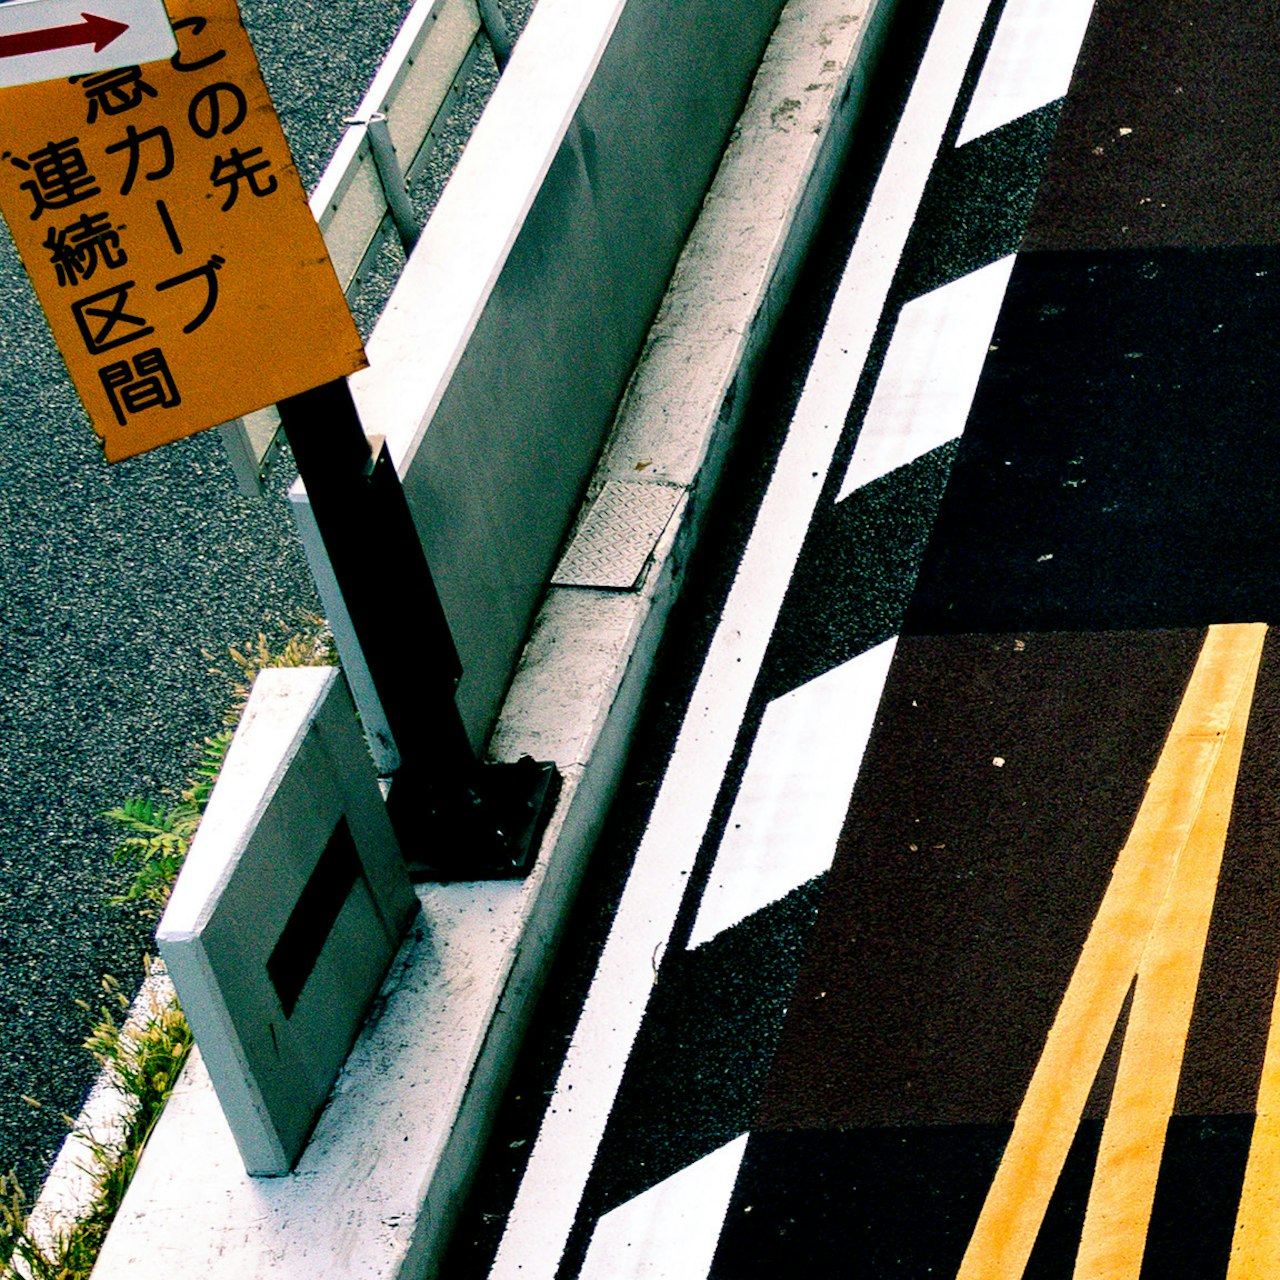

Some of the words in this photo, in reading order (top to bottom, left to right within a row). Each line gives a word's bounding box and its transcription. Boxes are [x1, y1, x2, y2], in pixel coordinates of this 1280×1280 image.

[171, 16, 278, 212] この先
[2, 137, 182, 426] 連続区間
